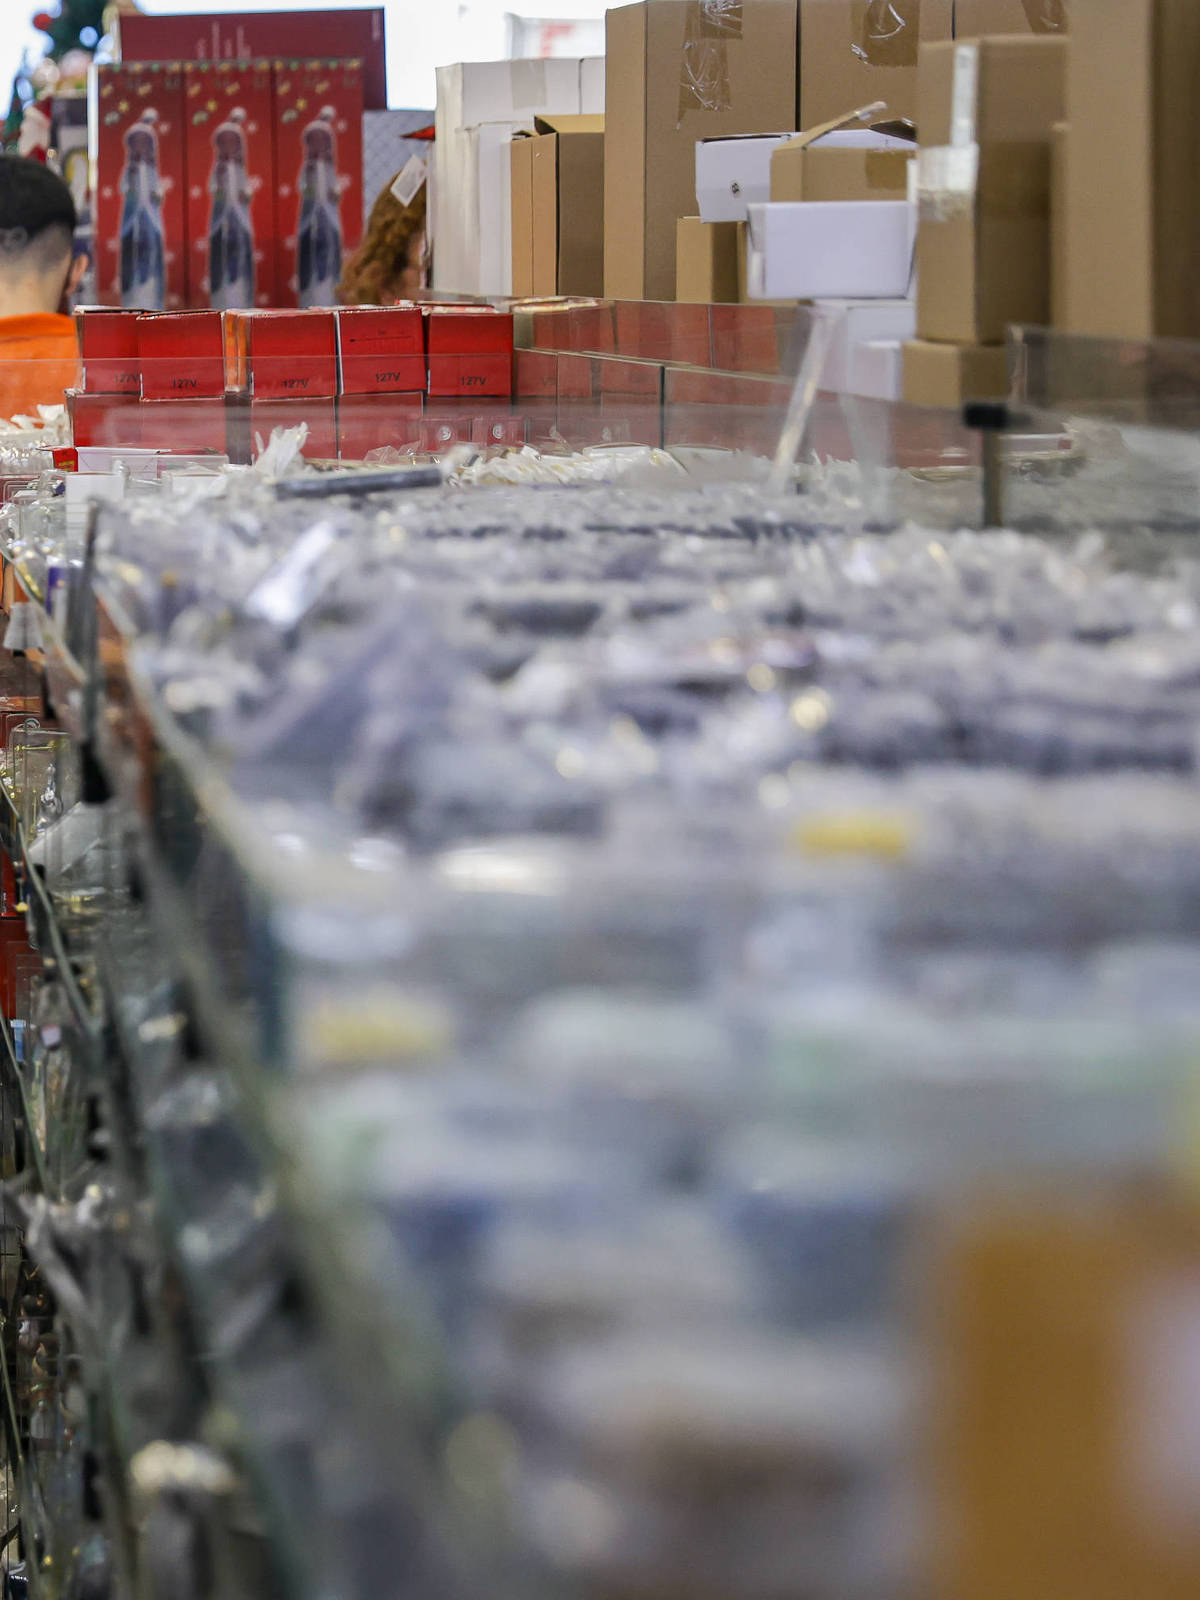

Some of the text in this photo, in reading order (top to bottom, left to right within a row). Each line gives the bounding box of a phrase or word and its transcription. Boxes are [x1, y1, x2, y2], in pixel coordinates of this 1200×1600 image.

[375, 371, 401, 383] 127V
[461, 375, 487, 386] 127V
[172, 378, 197, 389] 127V
